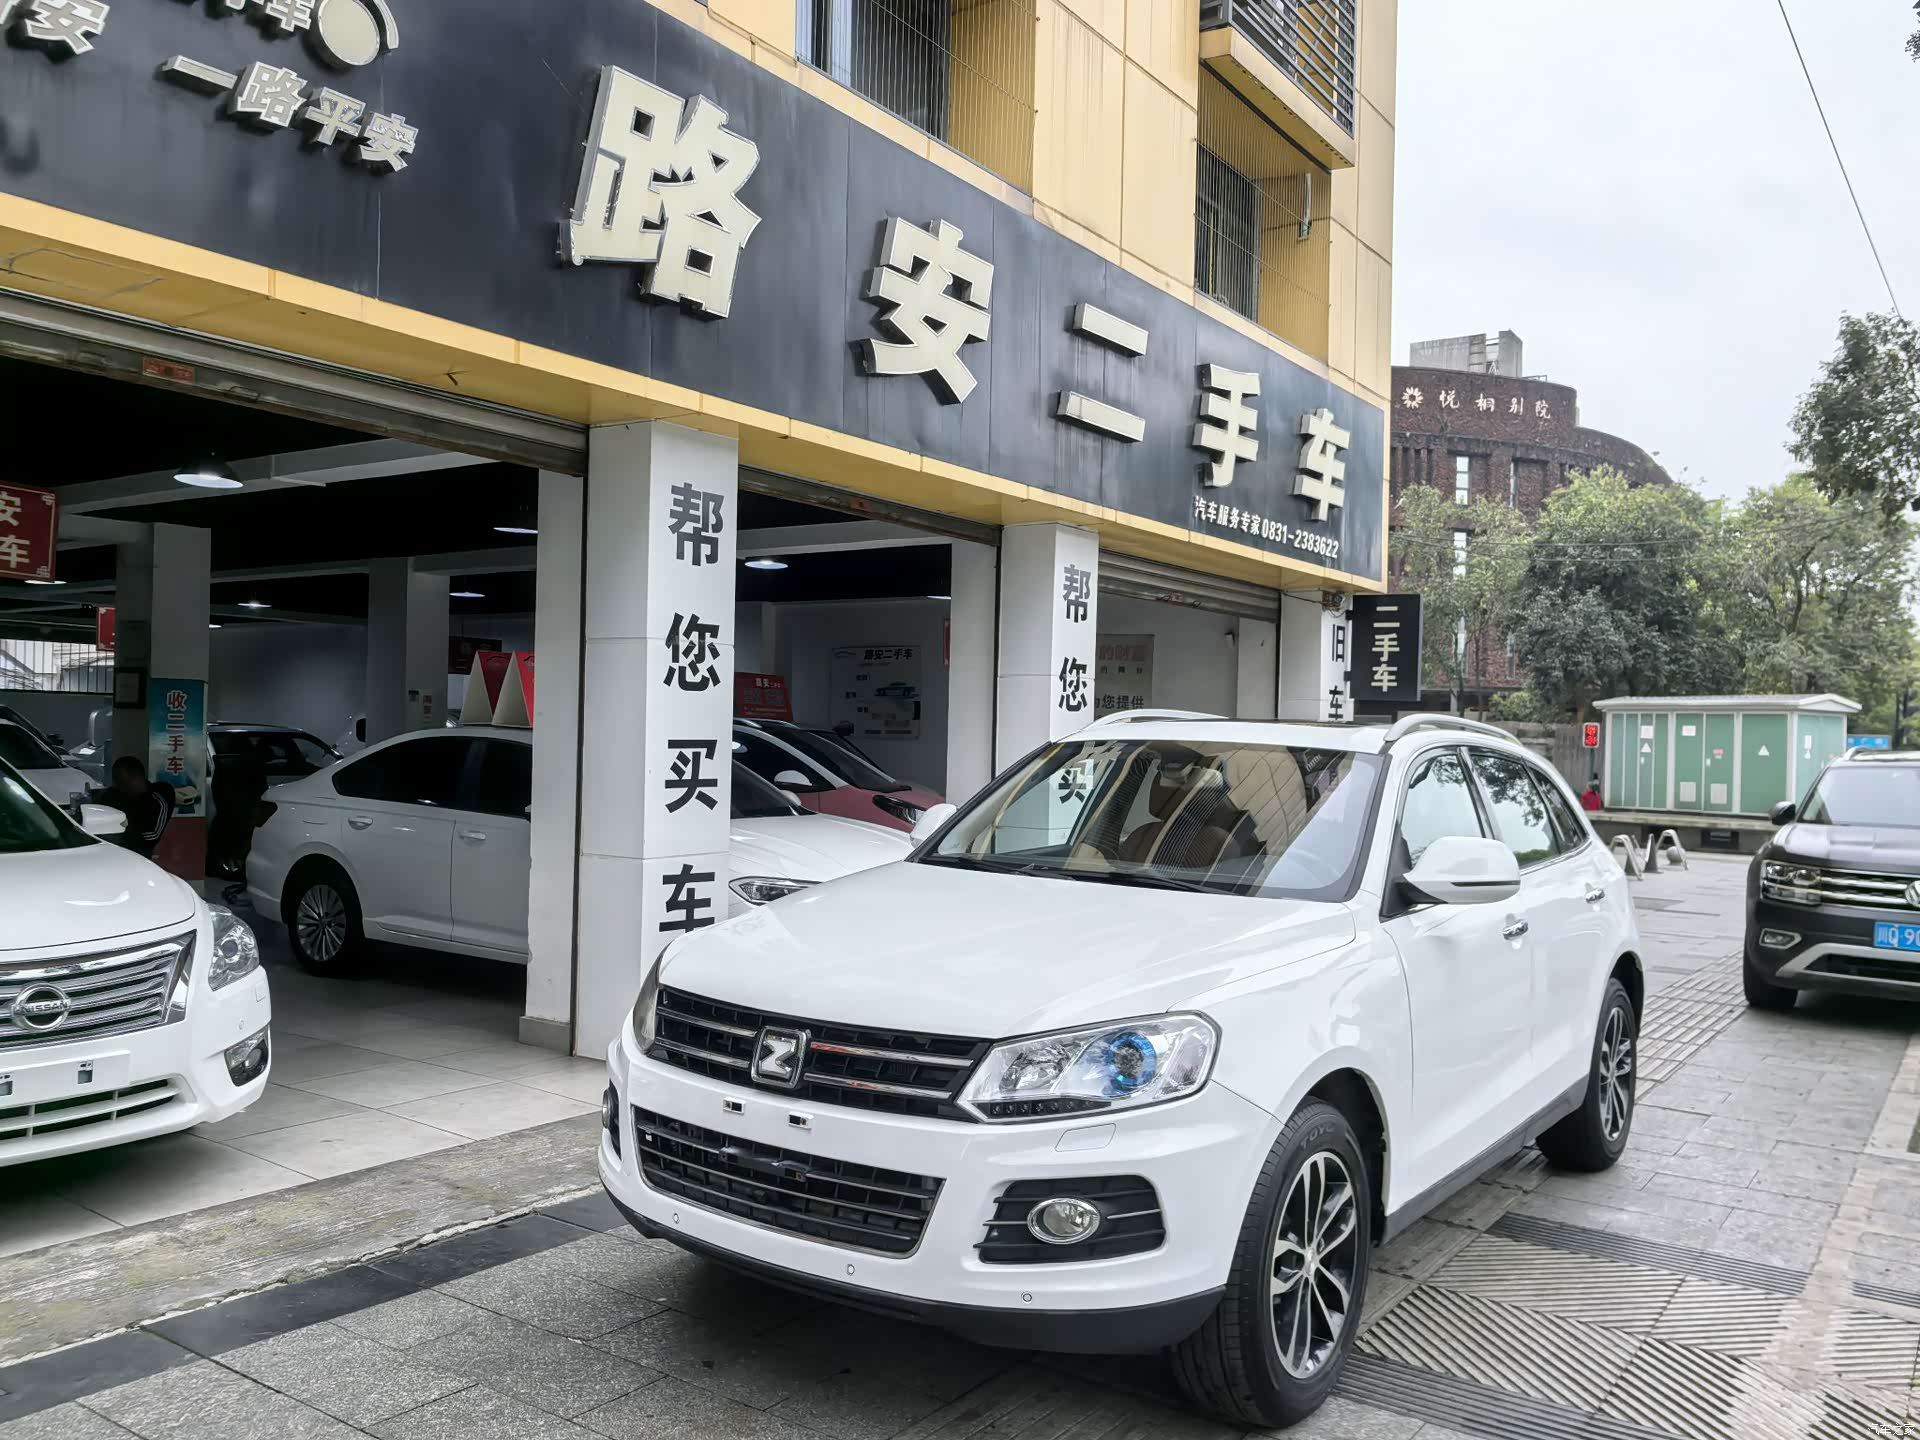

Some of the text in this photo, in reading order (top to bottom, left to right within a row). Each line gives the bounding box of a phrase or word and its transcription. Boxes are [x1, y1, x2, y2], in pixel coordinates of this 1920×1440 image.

[162, 54, 420, 172] 一路平安
[560, 65, 1351, 522] 路安二手车
[1328, 623, 1346, 721] 旧车
[1370, 605, 1401, 693] 二手车
[166, 689, 188, 775] 收二手车
[658, 481, 726, 934] 帮您买车
[22, 1002, 68, 1017] NISSAN
